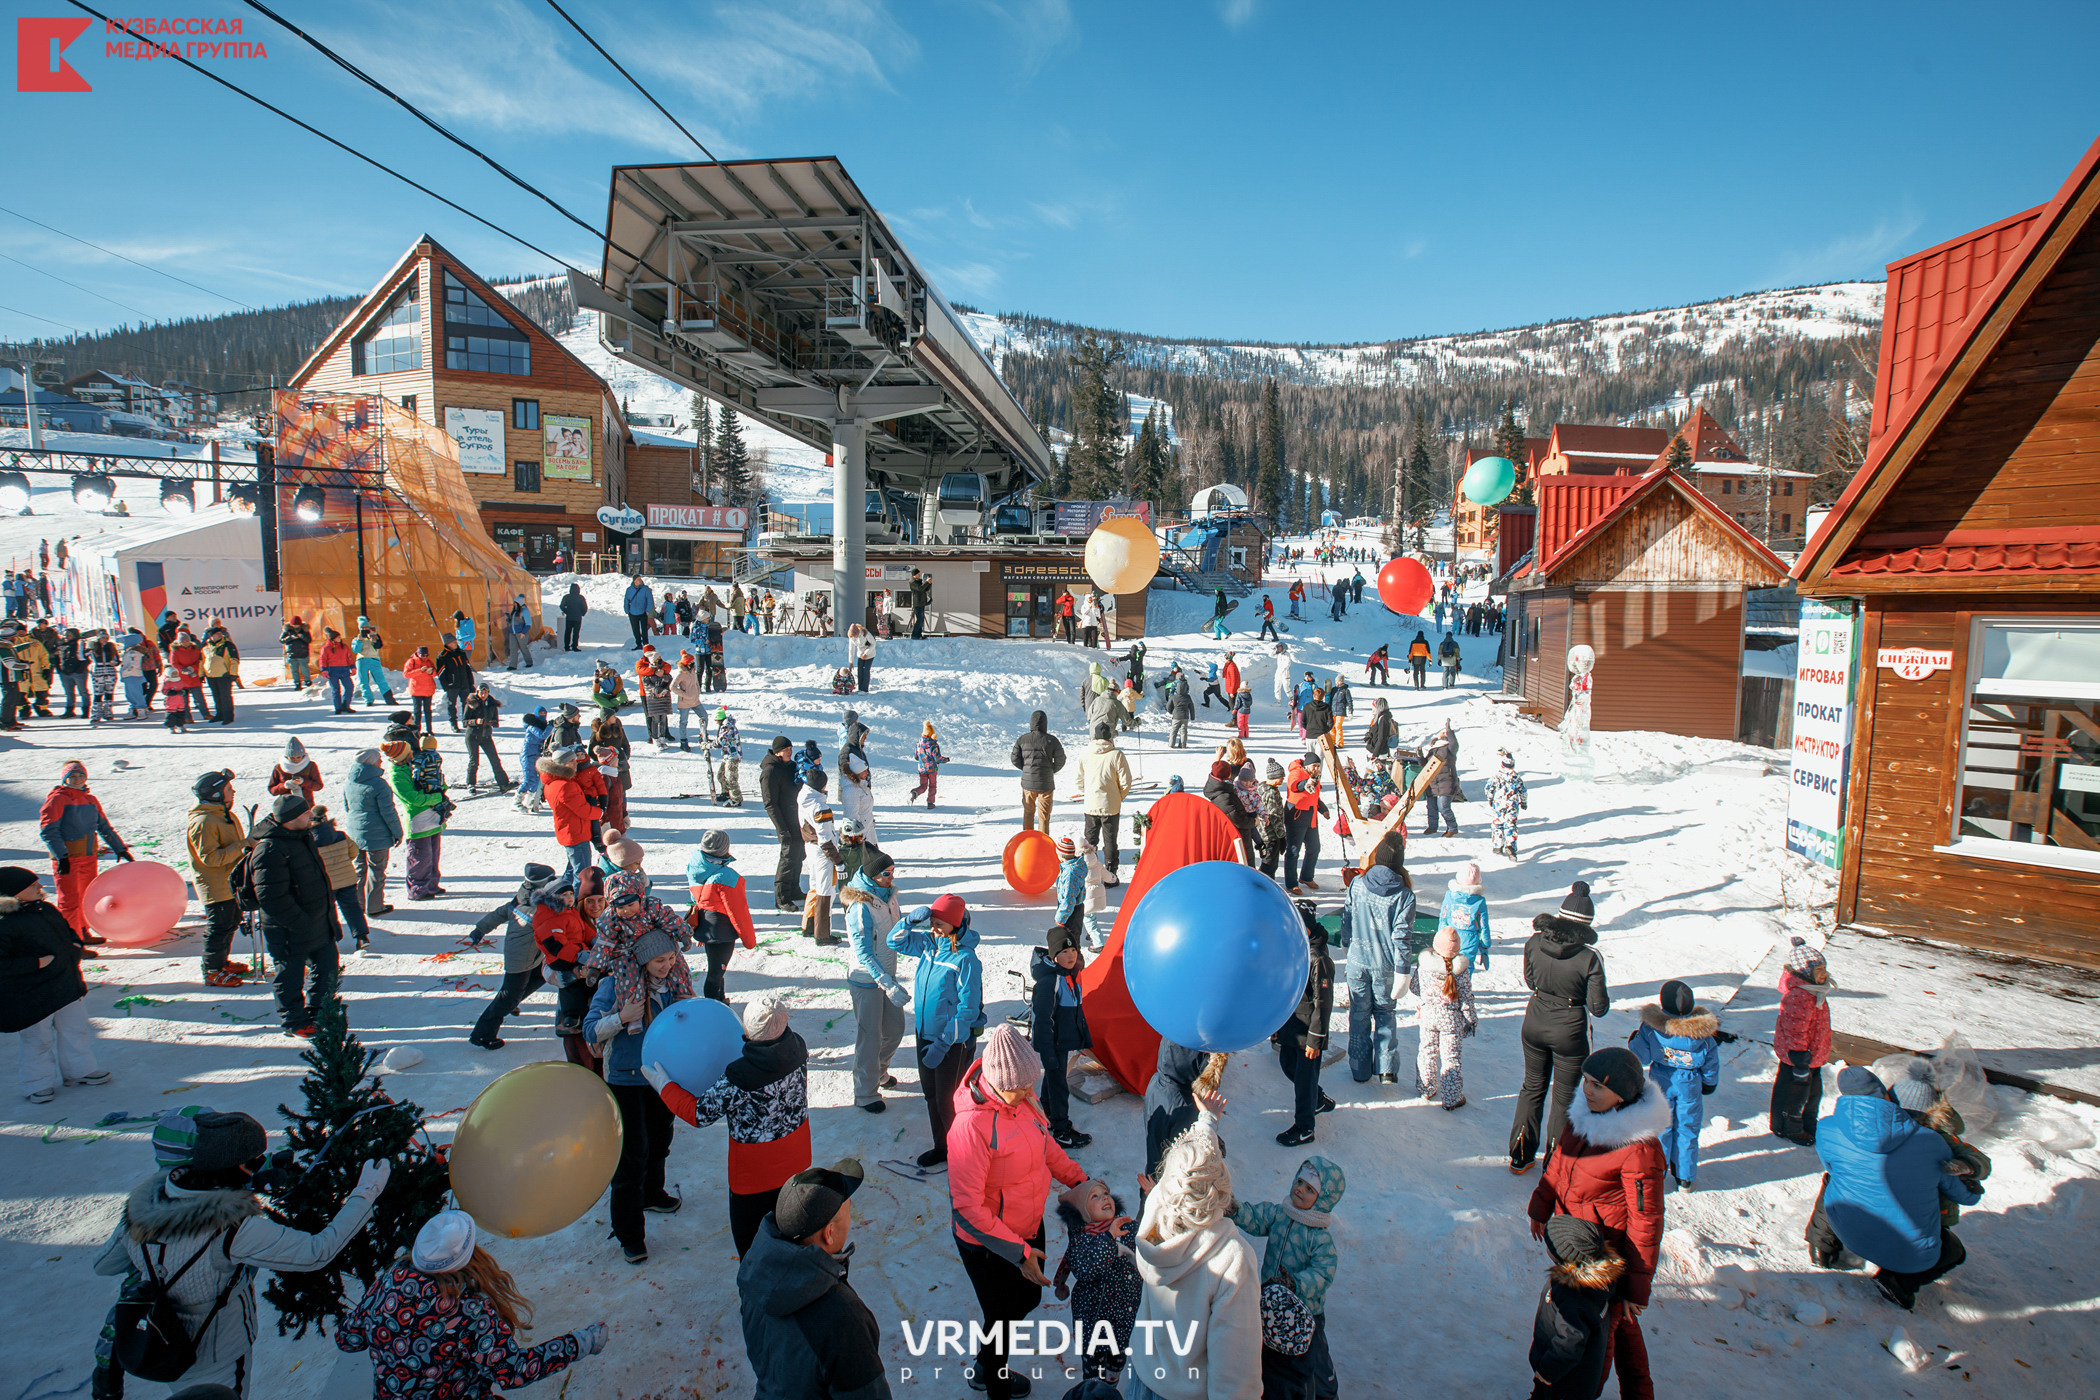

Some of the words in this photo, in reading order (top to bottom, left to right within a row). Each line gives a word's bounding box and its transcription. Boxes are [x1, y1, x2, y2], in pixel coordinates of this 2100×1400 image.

[462, 425, 489, 435] Туры
[467, 435, 493, 443] отель
[459, 441, 494, 451] Сугроб
[548, 457, 571, 465] ВОСЕМЬ
[600, 512, 643, 526] Сугроб
[650, 506, 706, 526] ПРОКАТ
[712, 509, 722, 526] #
[497, 528, 525, 536] КАФЕ
[182, 604, 278, 621] ЭКИПИРУ
[1880, 654, 1948, 665] СНЕЖНАЯ
[1799, 667, 1844, 685] ИГРОВАЯ
[1901, 665, 1920, 677] 44
[1796, 701, 1843, 723] ПРОКАТ
[1794, 734, 1840, 760] ИНСТРУКТОР
[1793, 768, 1838, 796] СЕРВИС
